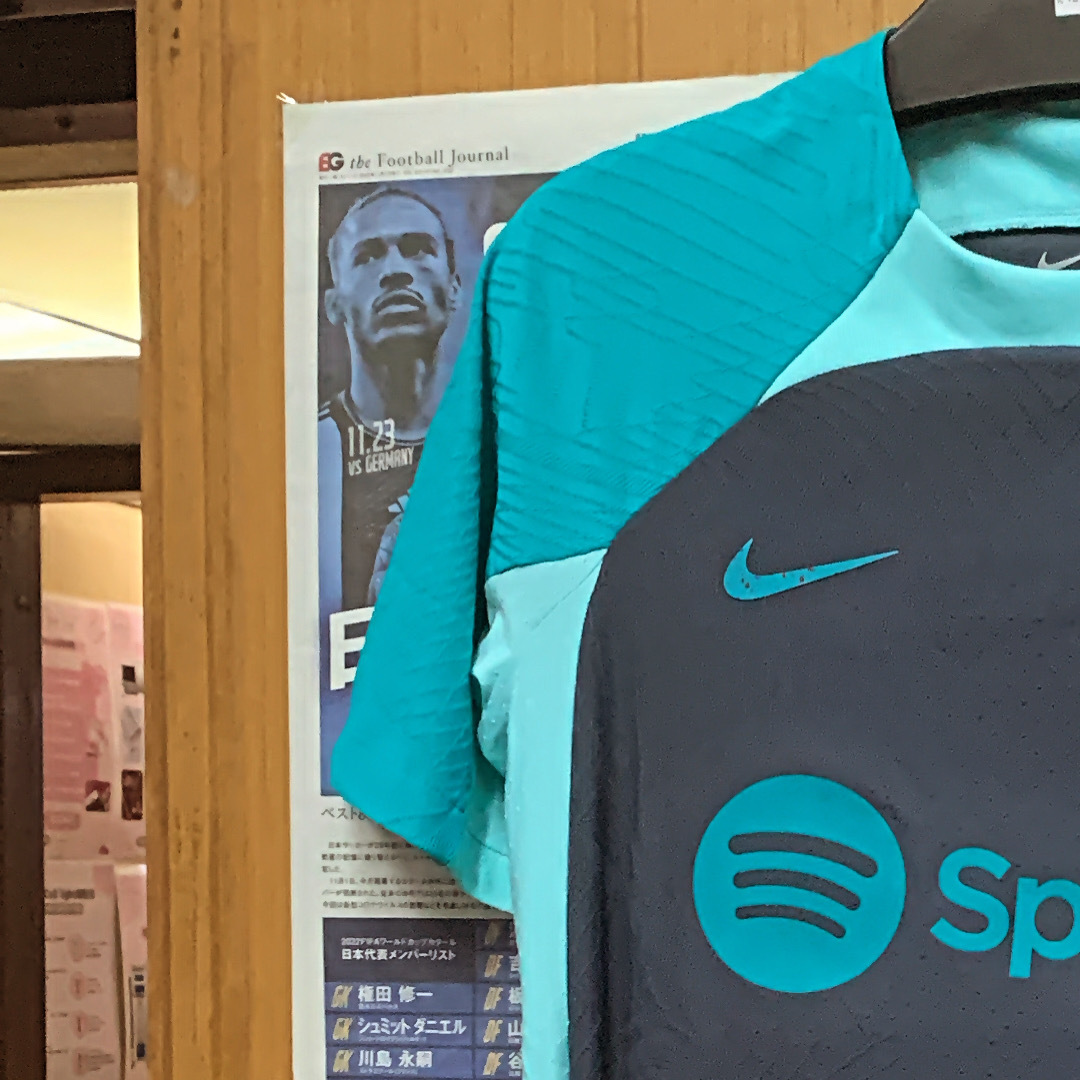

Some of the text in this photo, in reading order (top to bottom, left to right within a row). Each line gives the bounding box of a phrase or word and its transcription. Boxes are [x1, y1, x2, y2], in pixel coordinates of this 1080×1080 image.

[350, 154, 372, 170] the
[377, 150, 444, 168] Football
[448, 146, 510, 168] Journal
[348, 418, 396, 457] 11.23
[365, 445, 415, 473] GERMANY
[341, 948, 457, 961] 日本代表メンバーリスト
